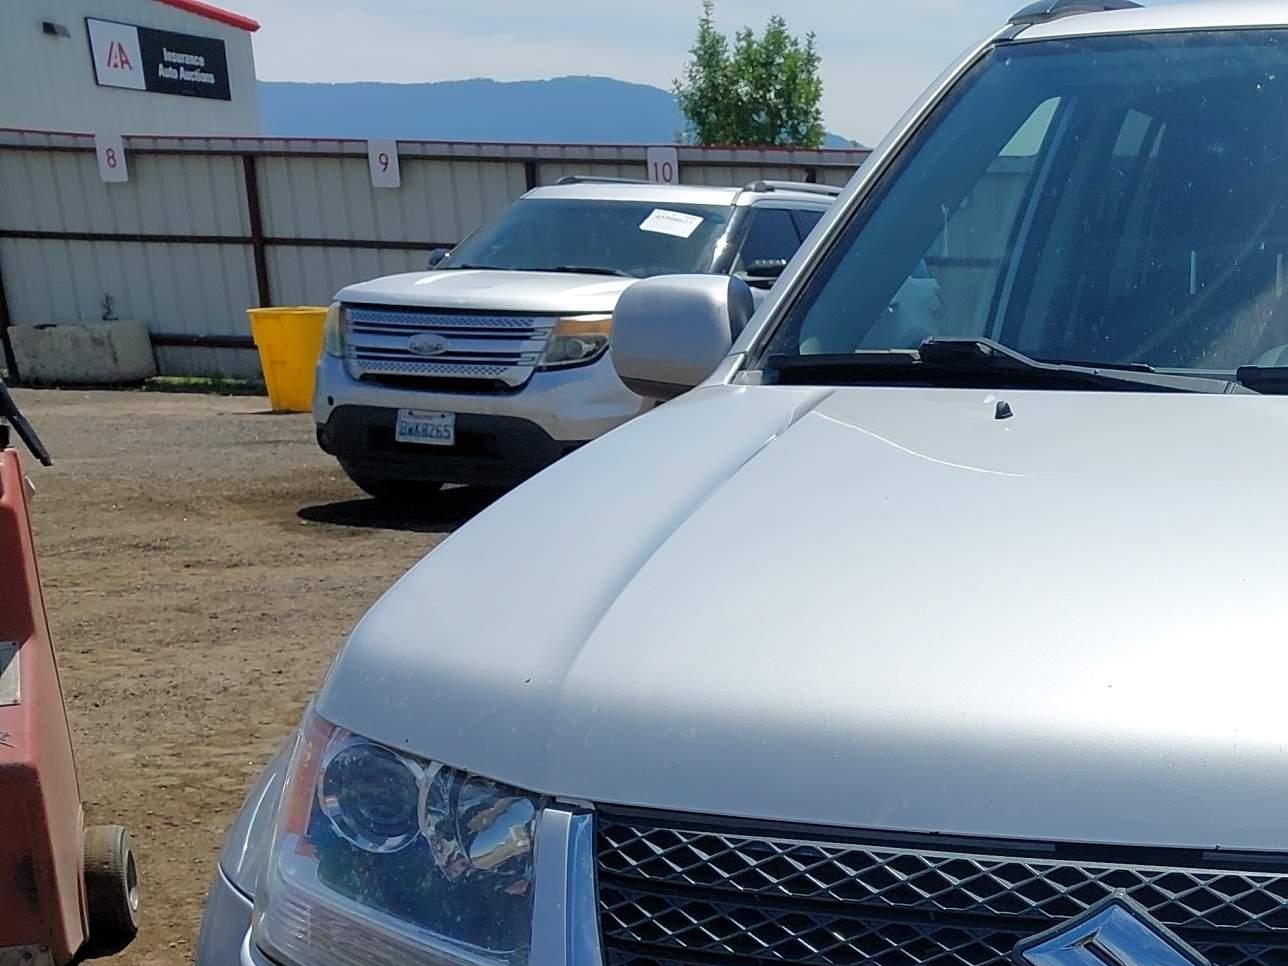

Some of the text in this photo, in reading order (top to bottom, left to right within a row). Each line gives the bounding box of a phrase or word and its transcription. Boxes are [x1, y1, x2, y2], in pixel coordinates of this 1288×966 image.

[162, 47, 205, 67] Insurance
[158, 63, 215, 84] Auto Auctions
[106, 148, 117, 168] 8
[378, 152, 389, 173] 9
[654, 162, 673, 183] 10
